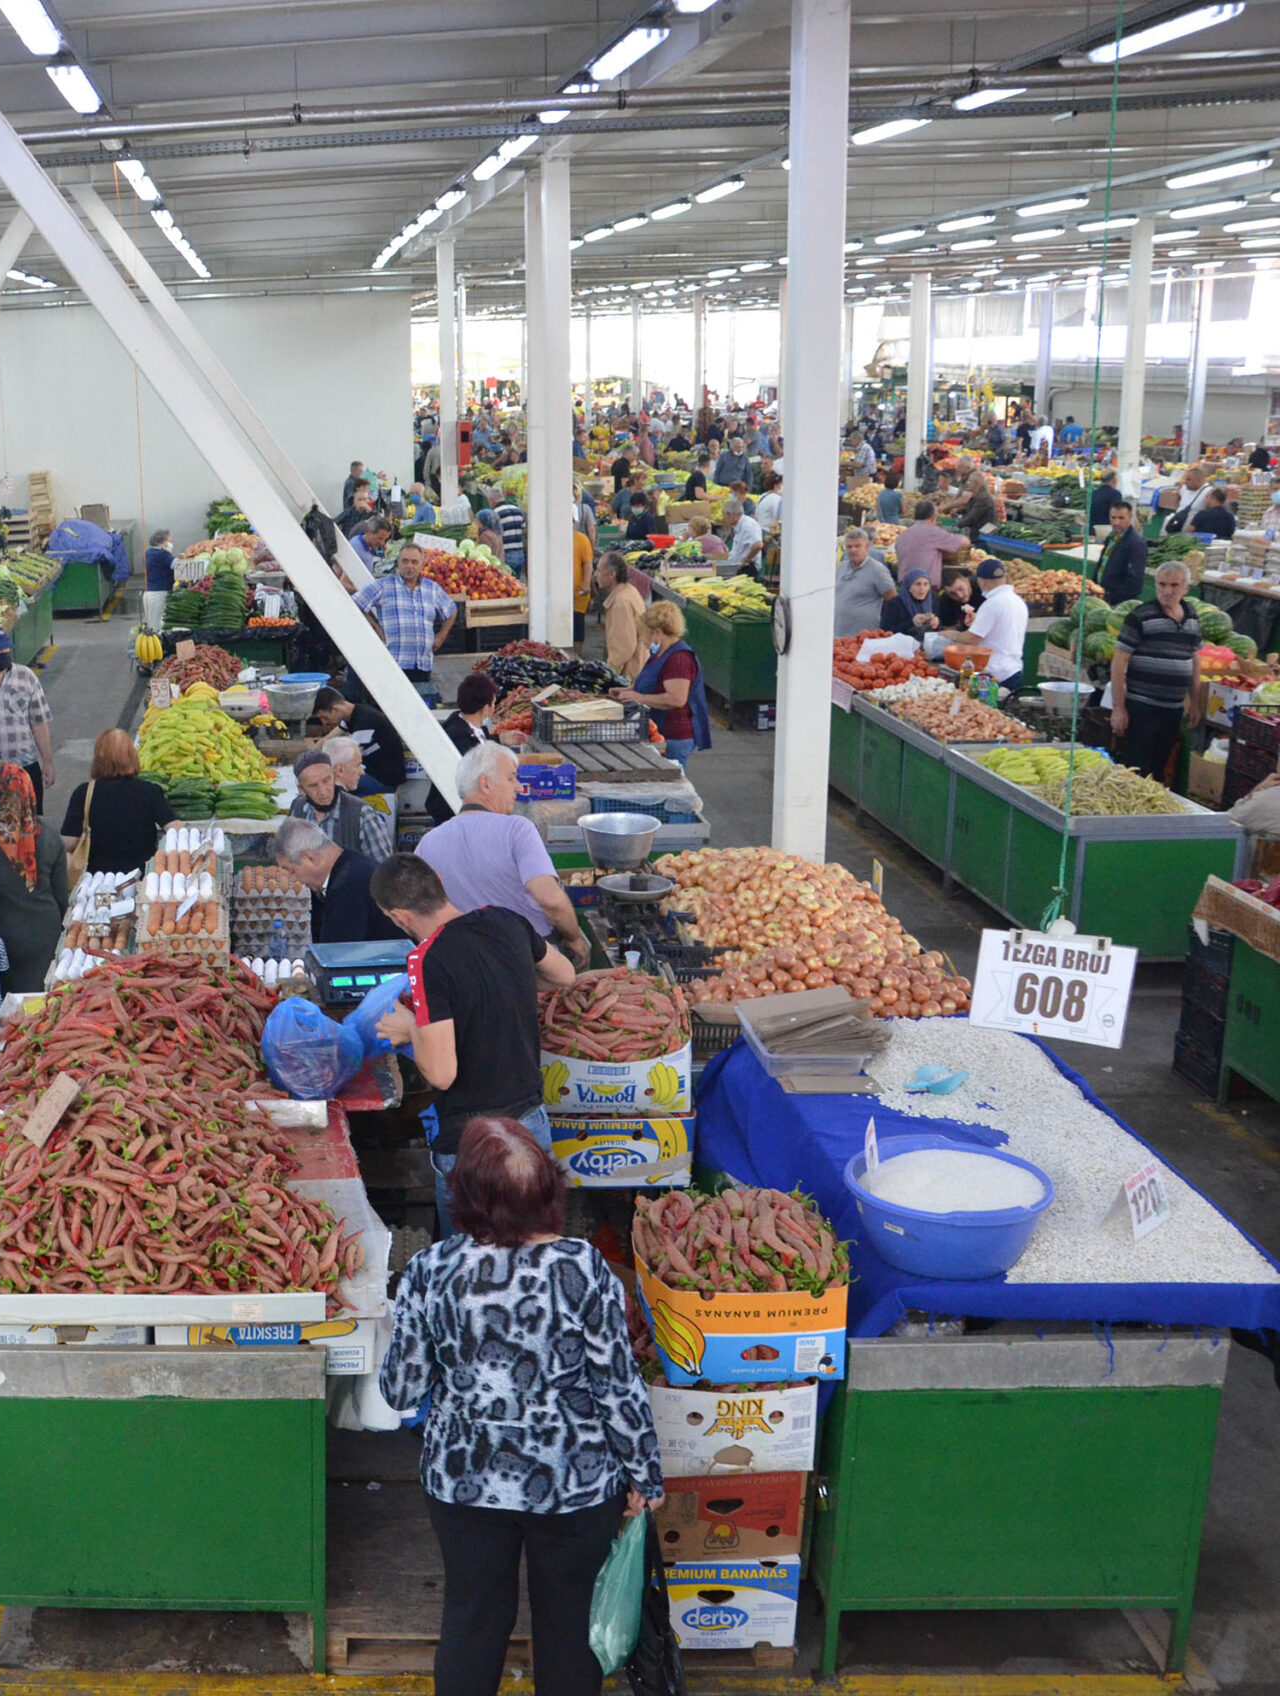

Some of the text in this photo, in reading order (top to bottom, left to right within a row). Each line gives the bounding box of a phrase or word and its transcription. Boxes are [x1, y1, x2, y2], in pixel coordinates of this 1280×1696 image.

[1002, 940, 1057, 968] TEZGA
[1014, 972, 1088, 1023] 608
[575, 1083, 637, 1103] BONITA
[589, 1120, 644, 1131] PREMIUM
[574, 1150, 642, 1173] derby
[1130, 1178, 1162, 1224] 120
[694, 1306, 828, 1318] PREMIUM BANANAS
[238, 1325, 295, 1340] FRESKITA
[716, 1399, 766, 1417] KING
[720, 1568, 788, 1579] BANANAS
[686, 1606, 745, 1629] derby
